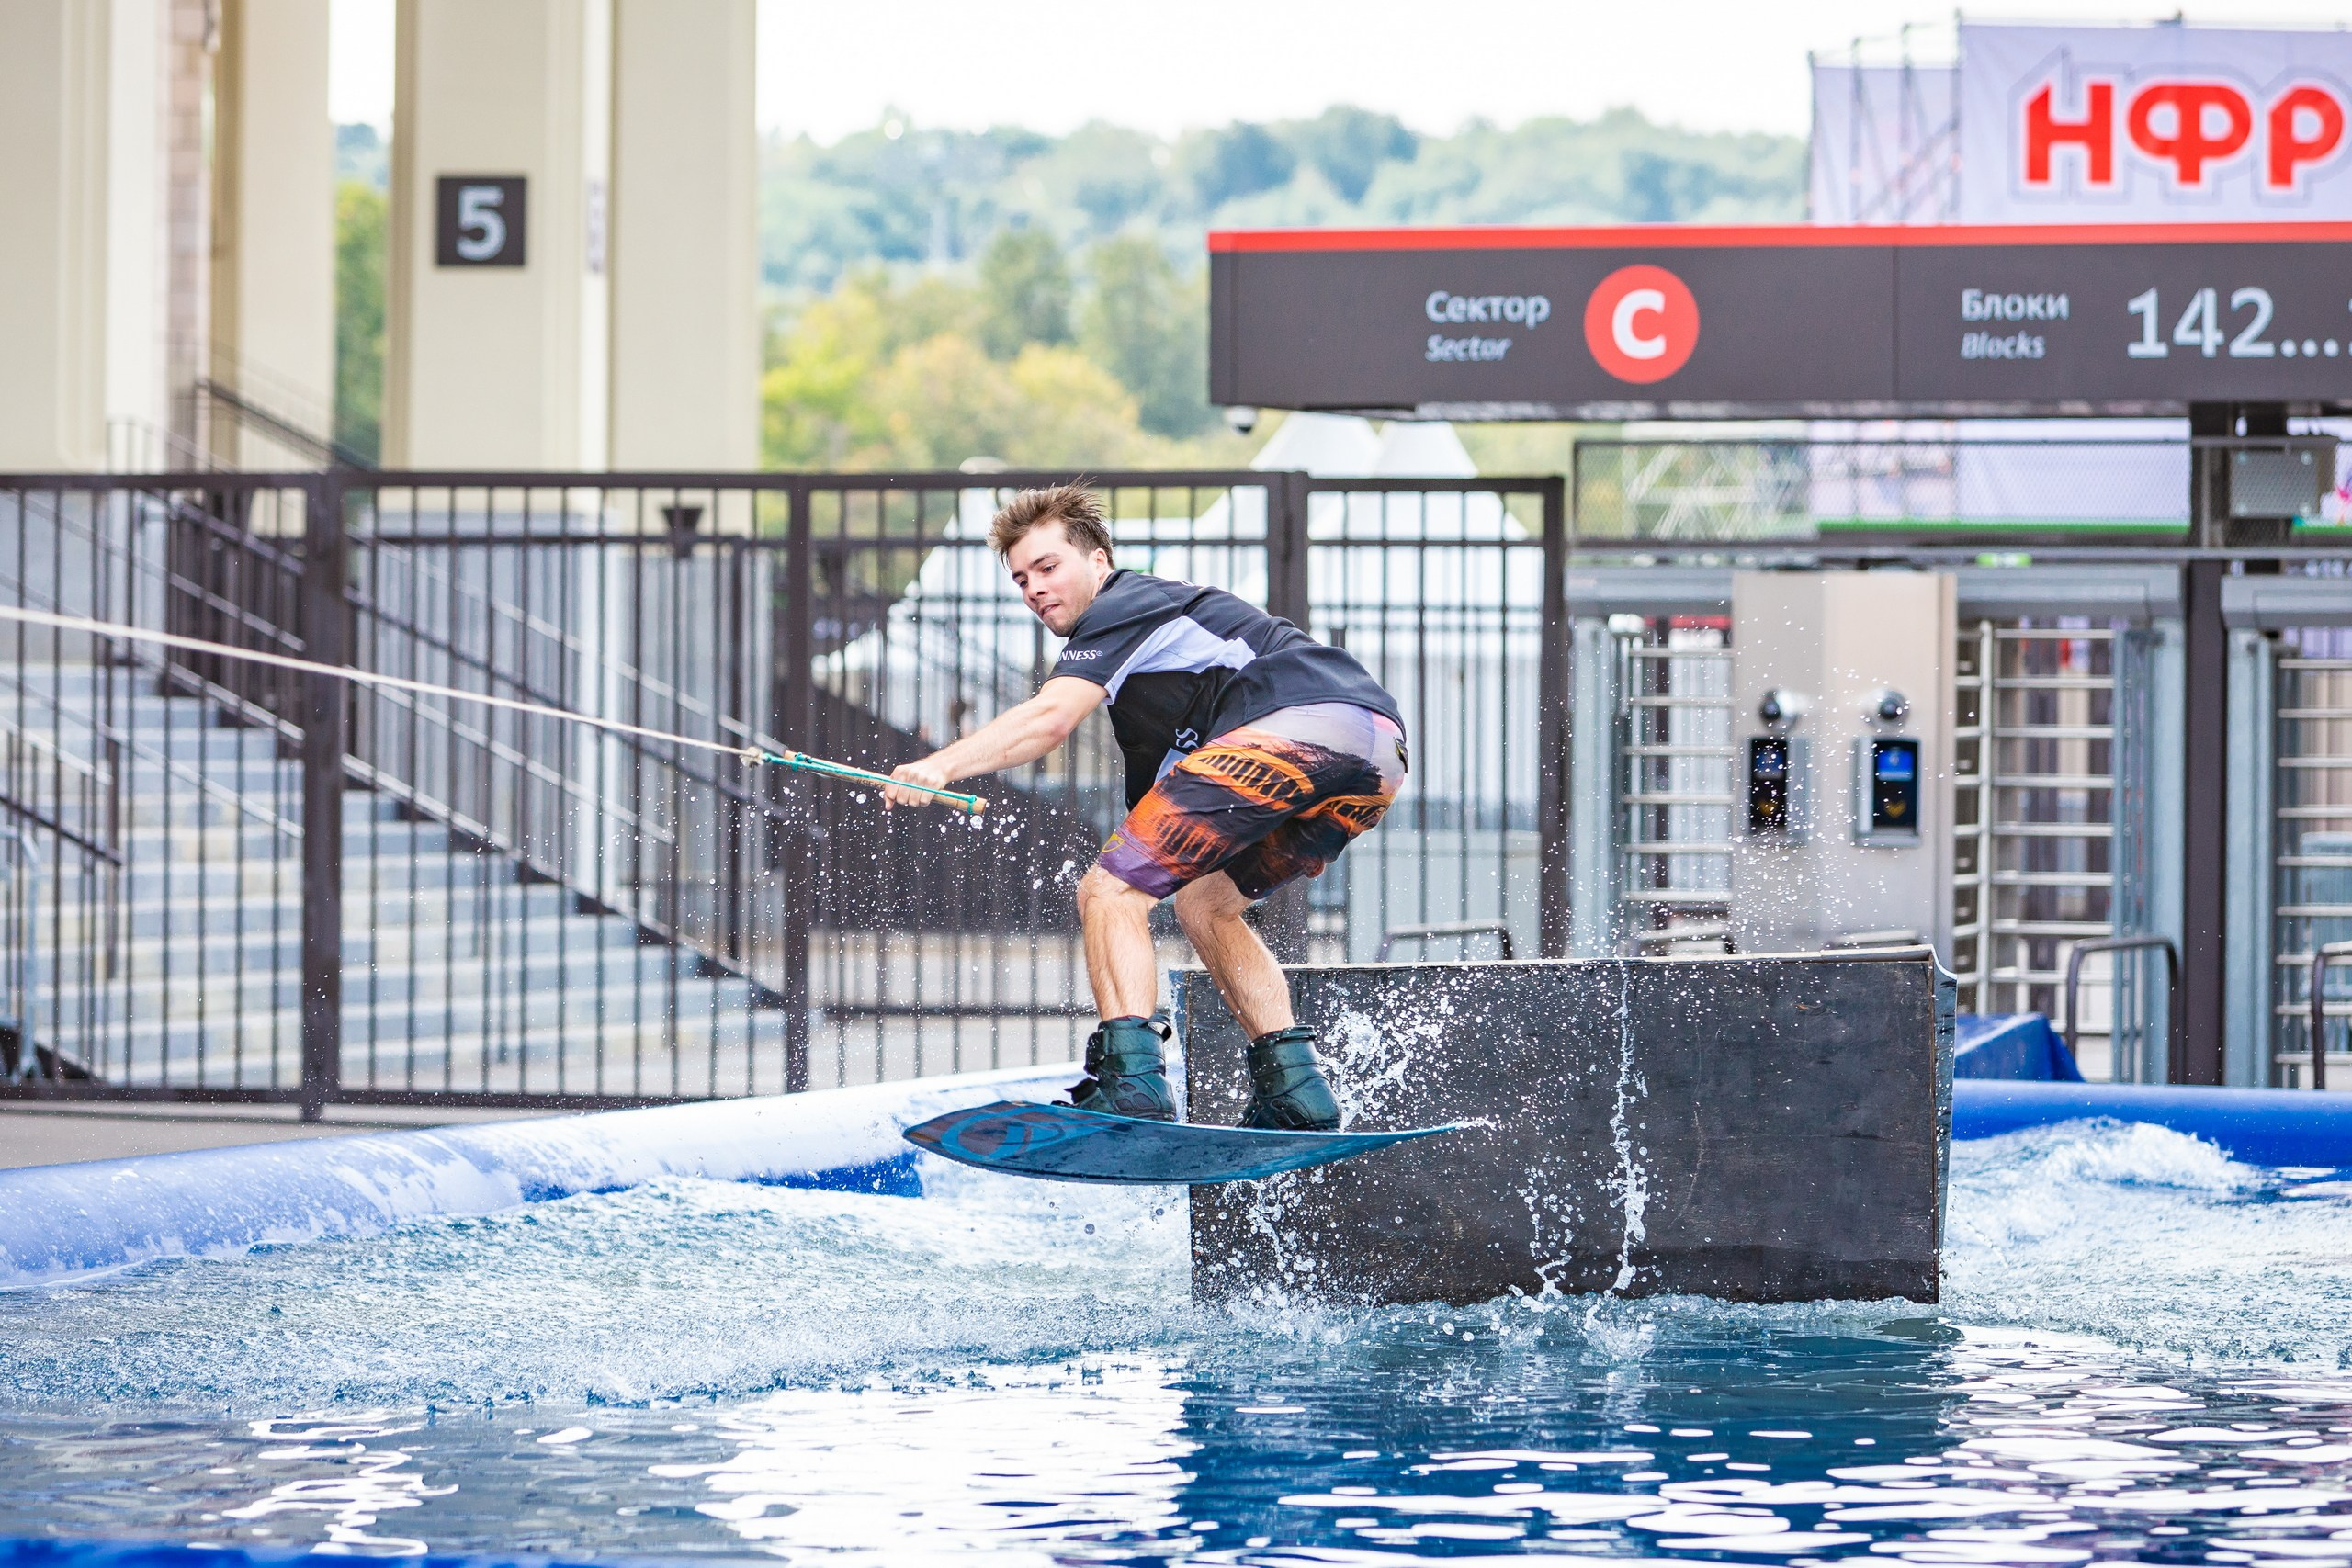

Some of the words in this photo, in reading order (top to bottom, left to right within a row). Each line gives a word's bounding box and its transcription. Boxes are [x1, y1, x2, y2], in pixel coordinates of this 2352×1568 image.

[457, 186, 506, 261] 5
[1425, 289, 1551, 330] Сектор
[1961, 288, 2070, 321] Блоки
[2127, 286, 2352, 358] 142...
[1424, 333, 1513, 362] Sector
[1960, 330, 2046, 359] Blocks
